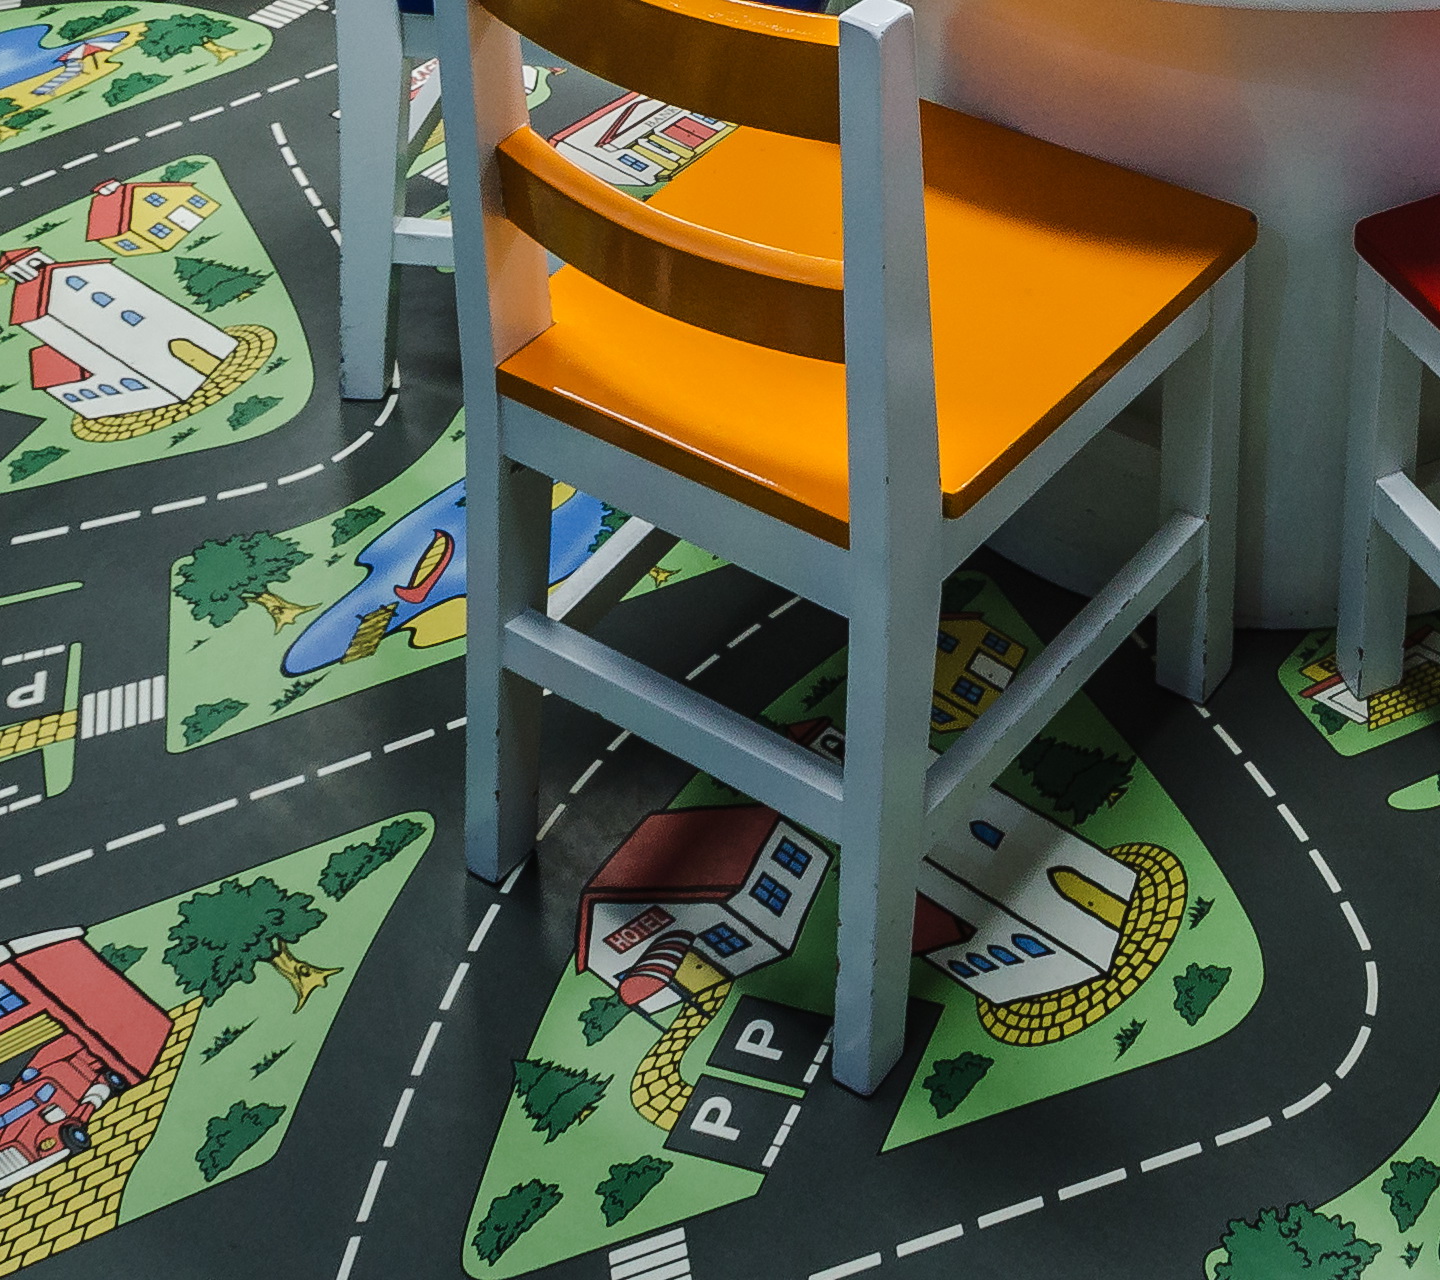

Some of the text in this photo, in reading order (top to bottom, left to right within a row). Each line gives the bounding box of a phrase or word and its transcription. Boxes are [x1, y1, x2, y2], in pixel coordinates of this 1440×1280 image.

[7, 671, 47, 708] P
[607, 906, 672, 954] HOTEL
[735, 1020, 782, 1061] P
[691, 1097, 739, 1140] P
